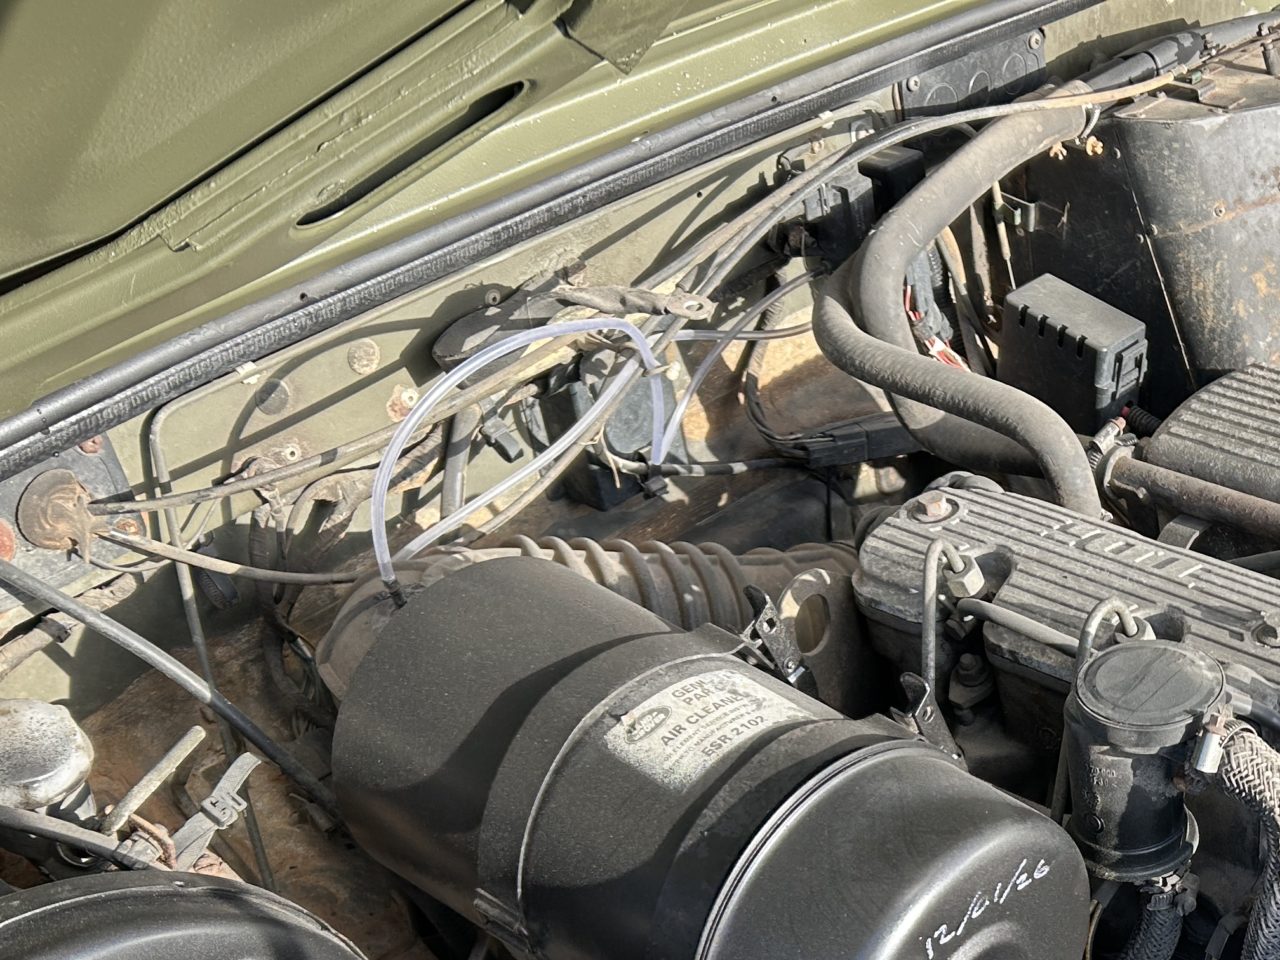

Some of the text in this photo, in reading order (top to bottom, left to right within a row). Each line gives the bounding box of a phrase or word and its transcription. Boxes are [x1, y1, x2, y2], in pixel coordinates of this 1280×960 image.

[660, 724, 688, 747] AIR
[702, 714, 768, 757] ESR 2102
[924, 858, 1051, 960] 12/01/26
